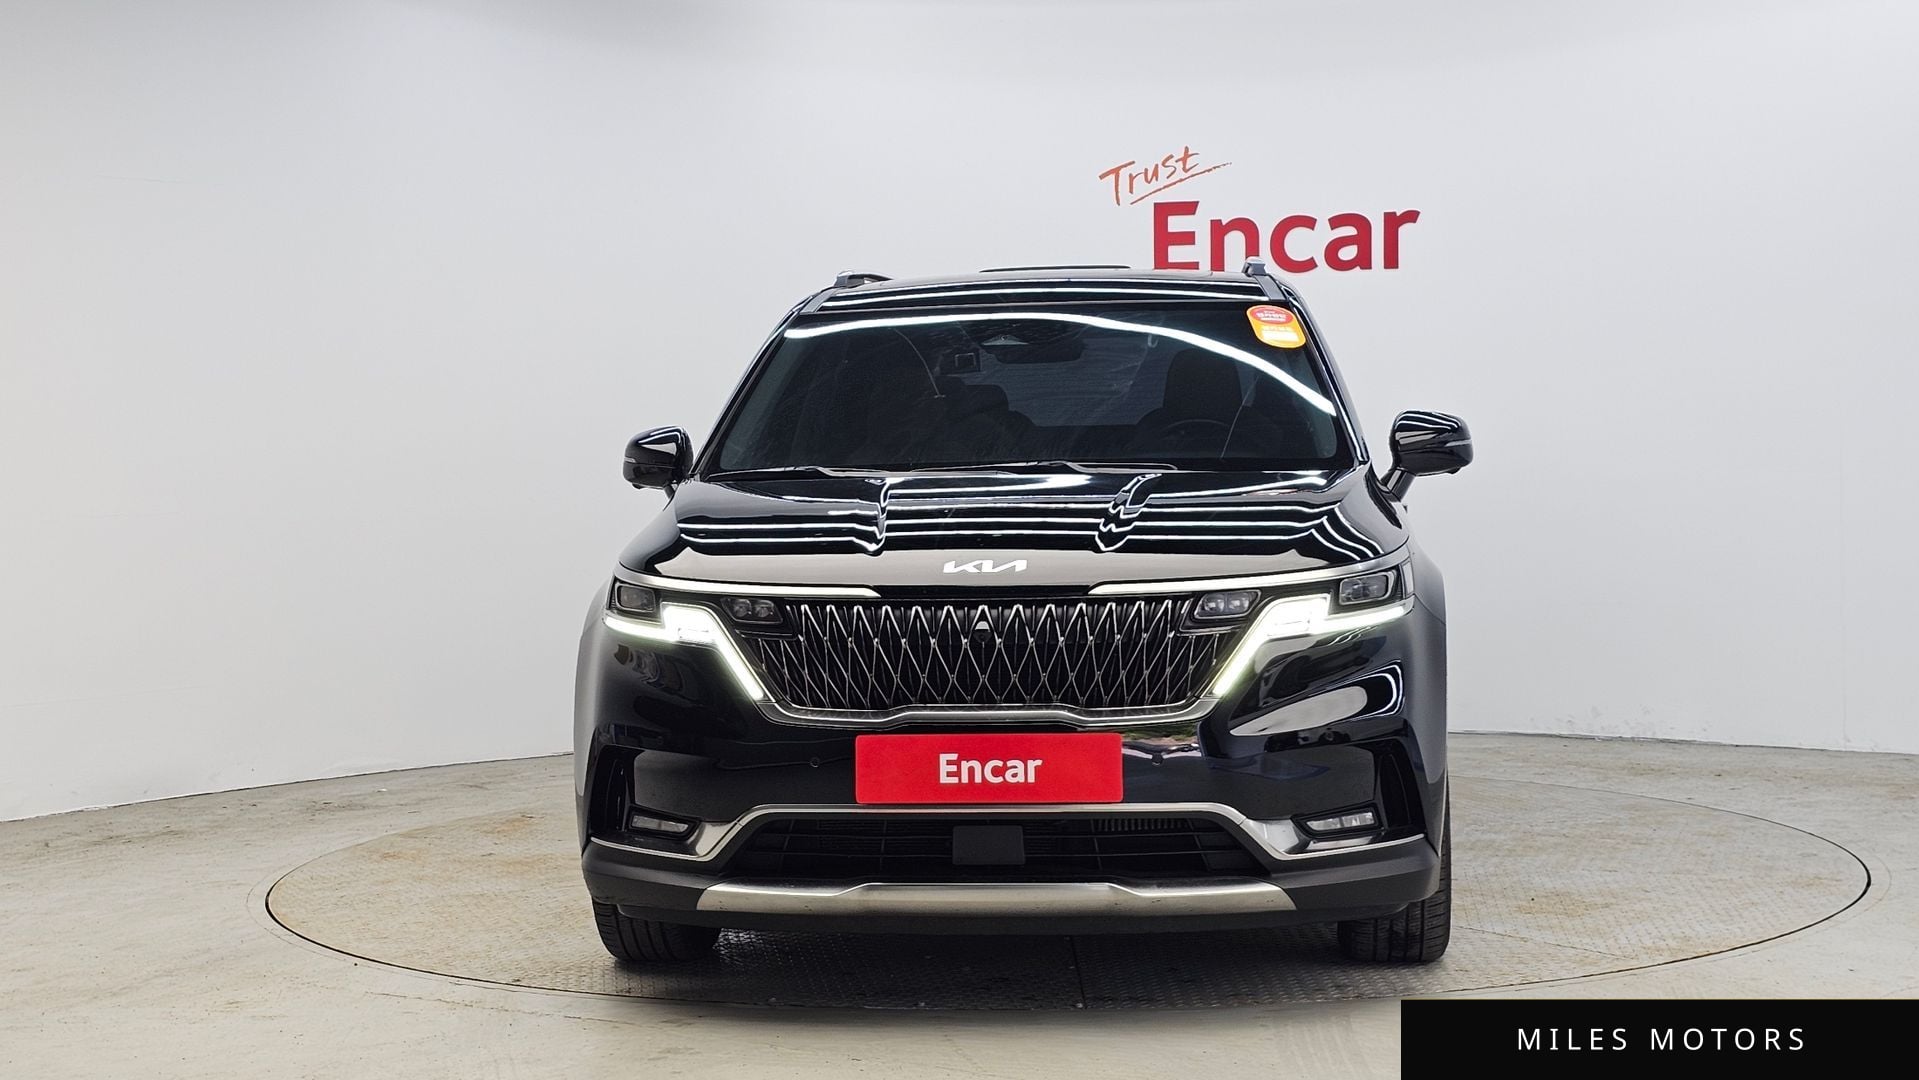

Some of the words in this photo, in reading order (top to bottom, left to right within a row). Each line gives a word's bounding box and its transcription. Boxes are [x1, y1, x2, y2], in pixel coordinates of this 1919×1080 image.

[1098, 146, 1200, 206] Trust
[1153, 200, 1421, 274] Encar
[938, 753, 1043, 784] Encar
